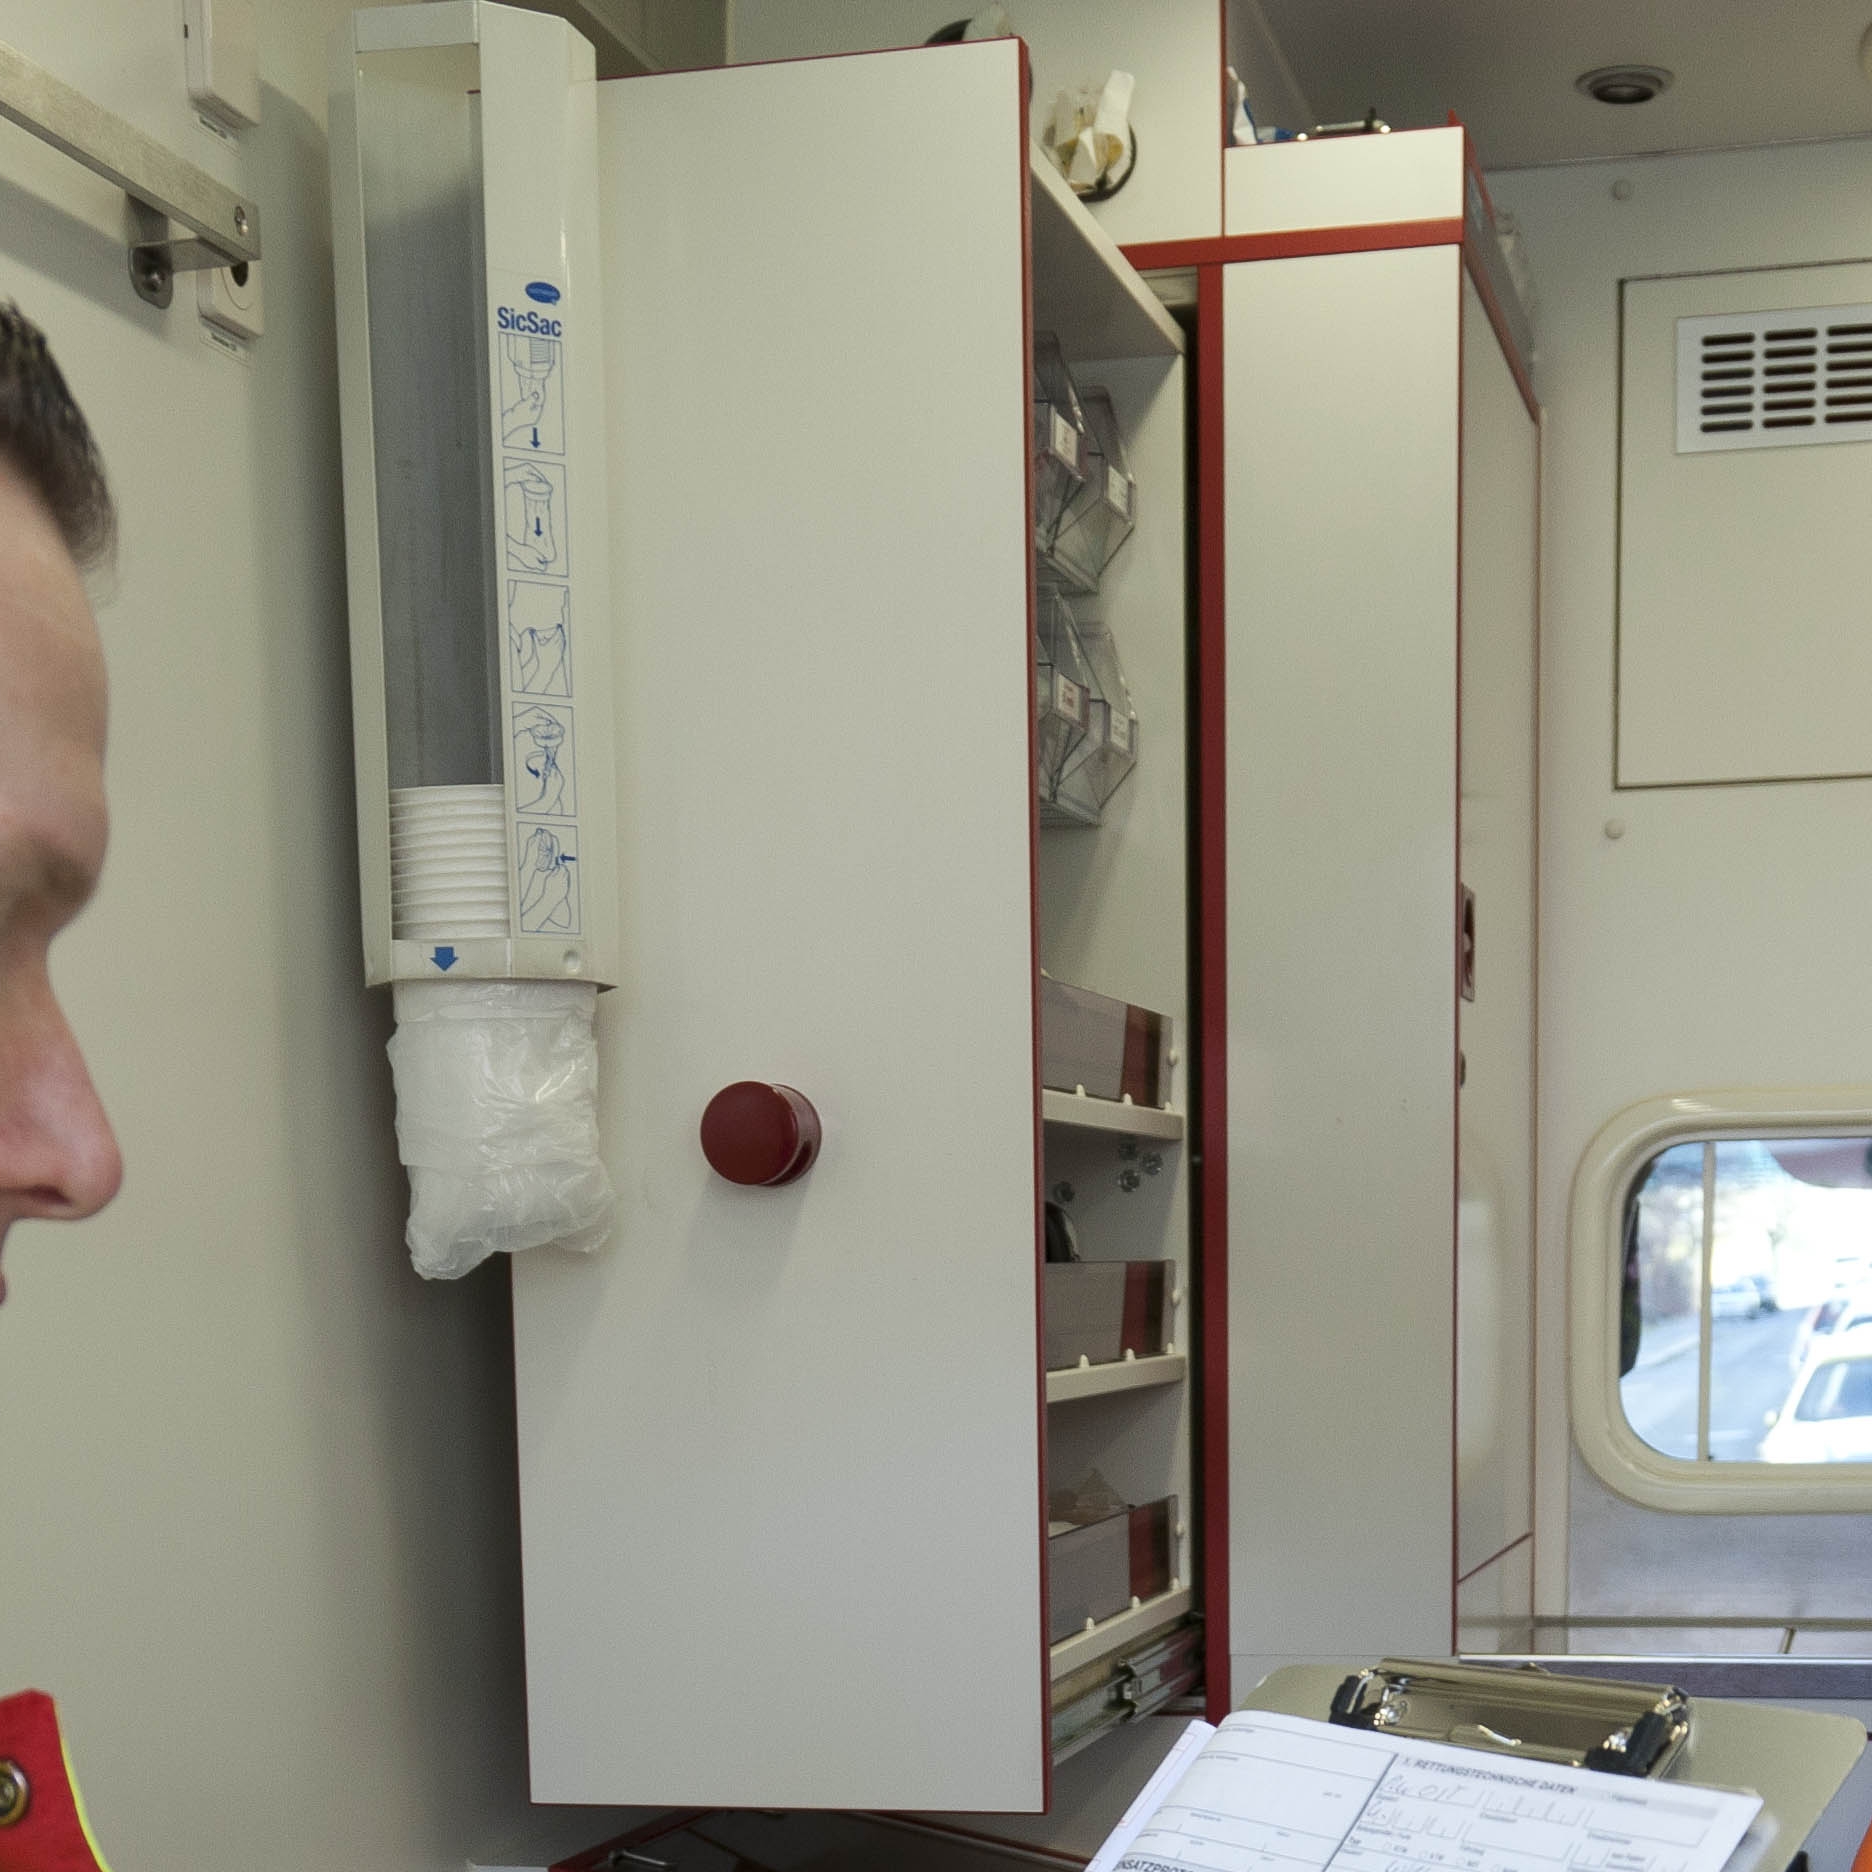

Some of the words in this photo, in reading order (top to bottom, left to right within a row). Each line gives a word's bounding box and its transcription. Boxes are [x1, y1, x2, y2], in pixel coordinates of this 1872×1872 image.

[497, 306, 562, 337] SicSac
[1415, 1758, 1538, 1793] RETTUNGSTECHNISCHE
[1539, 1781, 1578, 1796] DATEN
